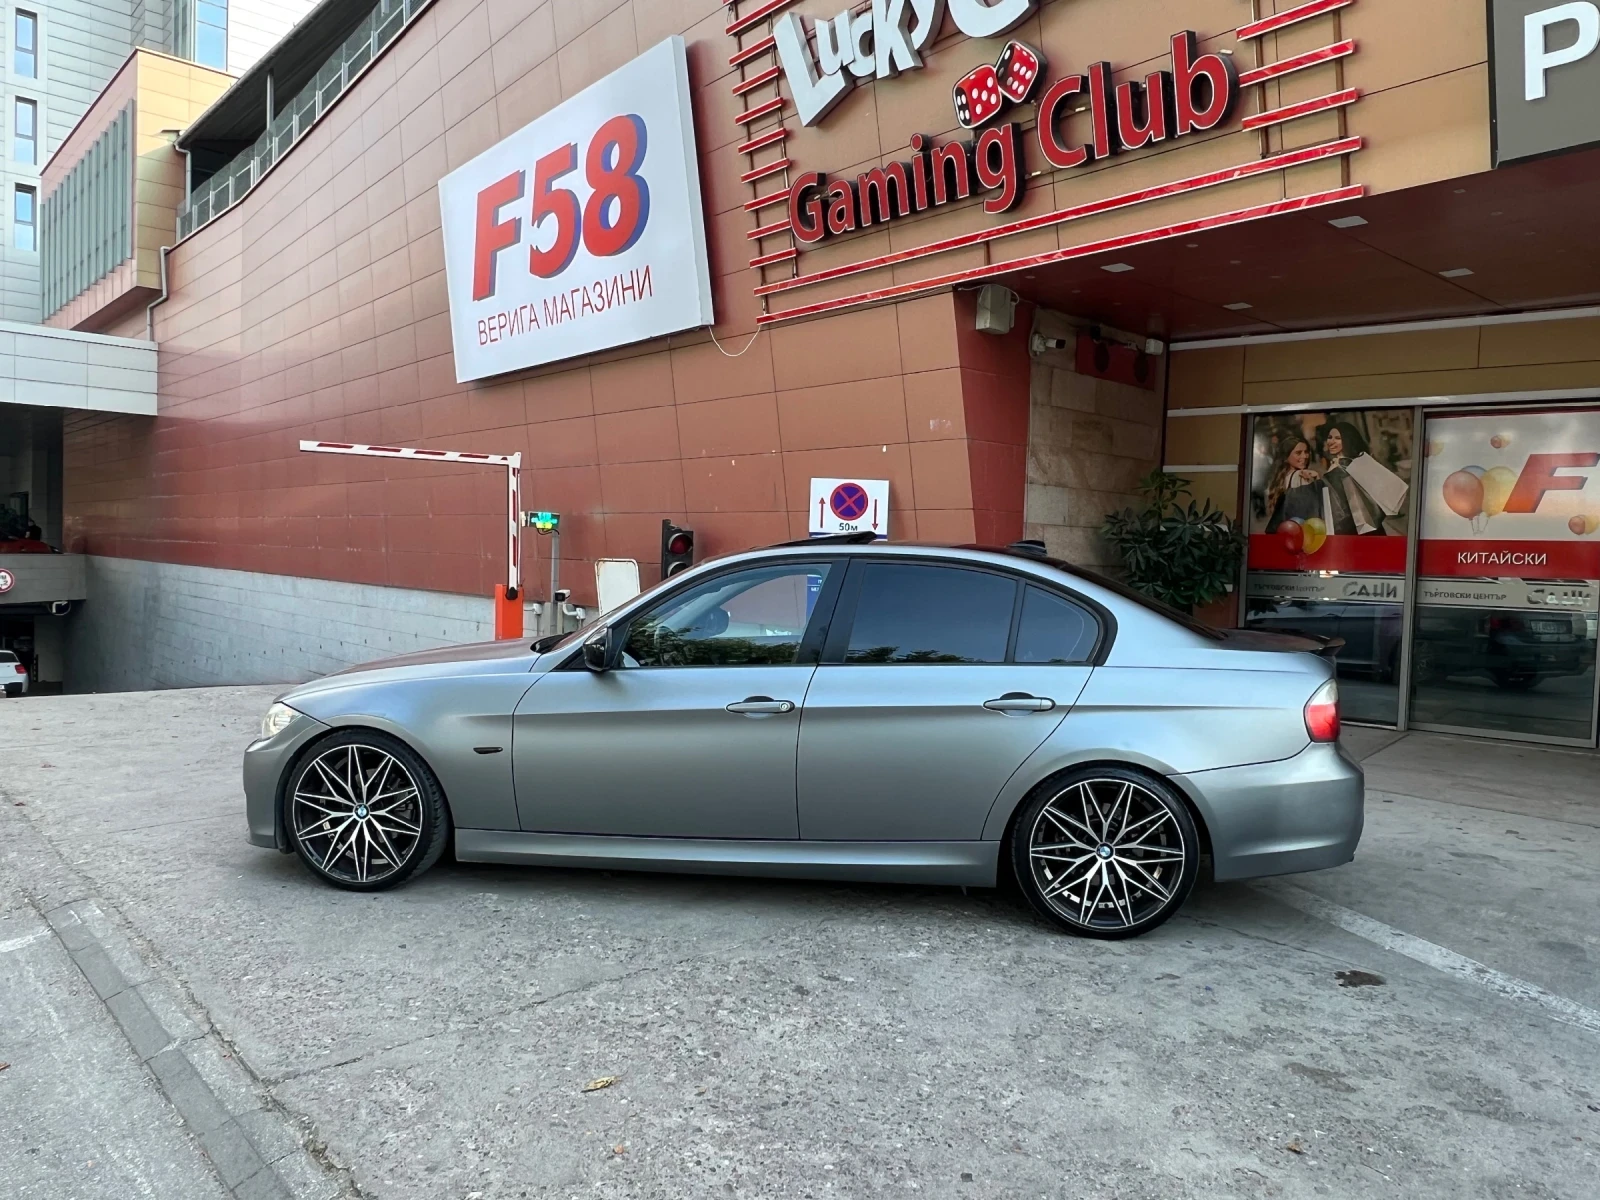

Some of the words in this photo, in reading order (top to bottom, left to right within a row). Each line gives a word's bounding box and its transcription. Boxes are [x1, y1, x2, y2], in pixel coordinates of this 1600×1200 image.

[1524, 1, 1600, 101] P
[788, 122, 1021, 243] Gaming
[1037, 30, 1236, 169] Club
[473, 113, 650, 301] F58
[478, 303, 540, 346] ВЕРИГА
[543, 265, 653, 327] МАГАЗИНИ
[1424, 590, 1471, 599] ТЪРГОВСКИ
[1473, 592, 1507, 601] ЦЕНТЪР
[1457, 550, 1547, 565] КИТАЙСКИ
